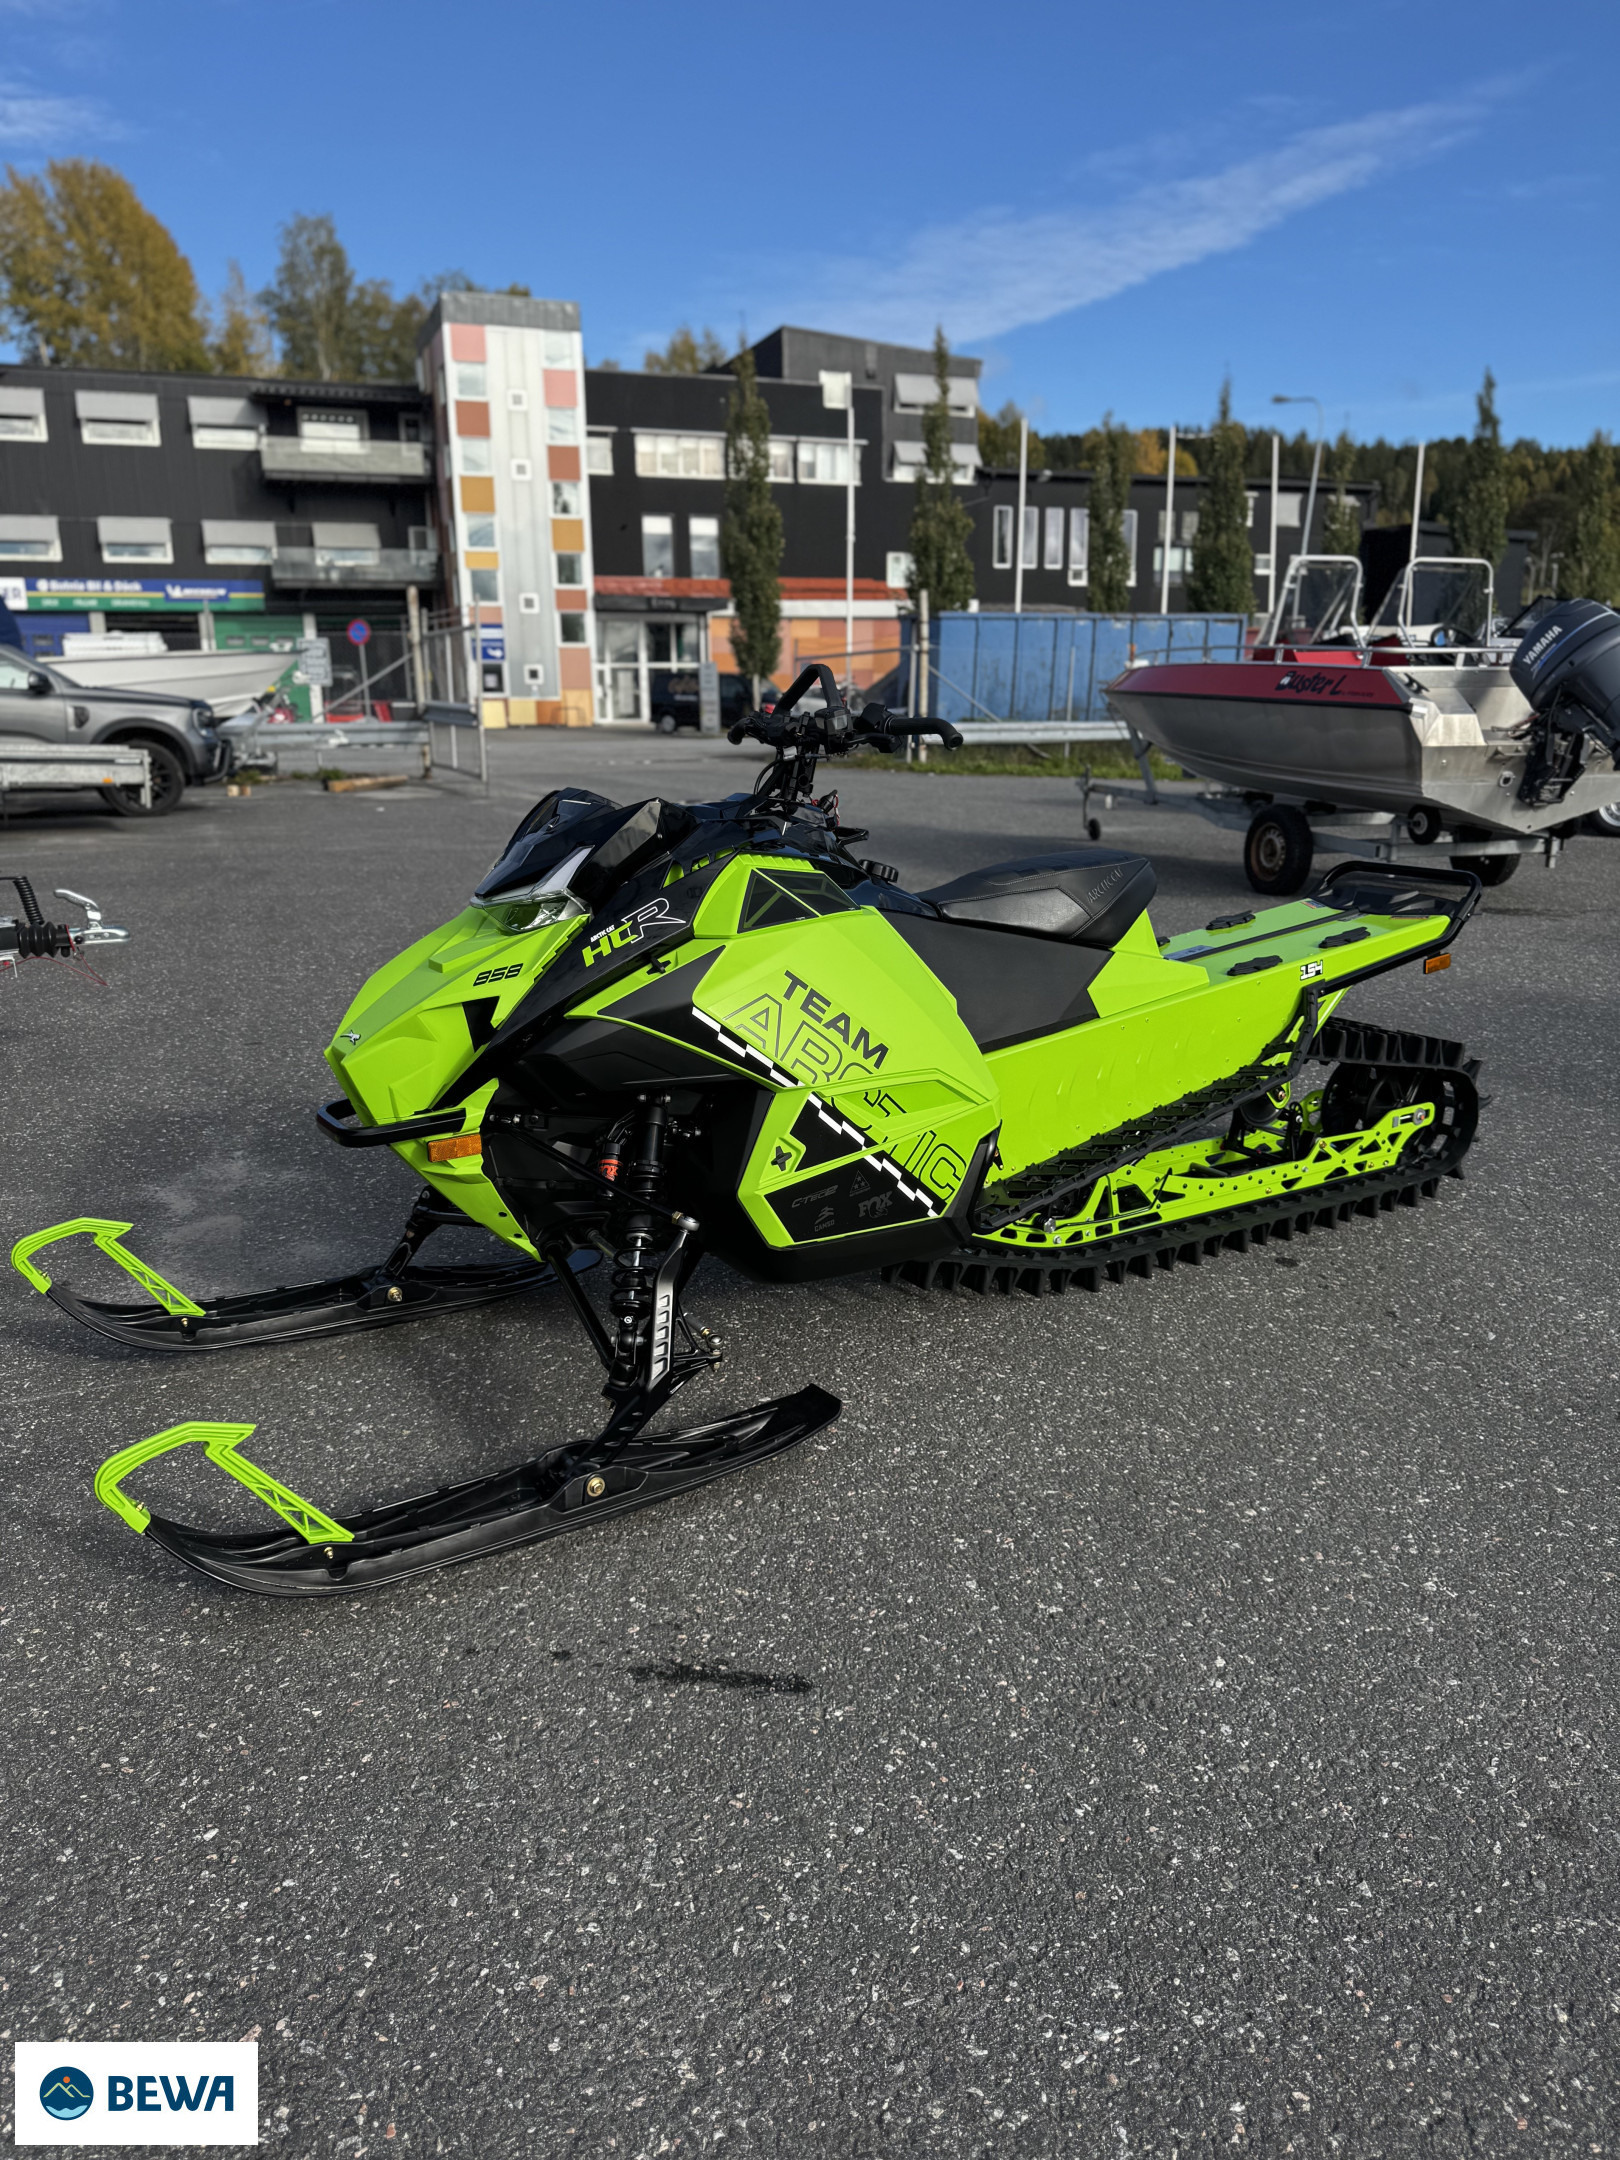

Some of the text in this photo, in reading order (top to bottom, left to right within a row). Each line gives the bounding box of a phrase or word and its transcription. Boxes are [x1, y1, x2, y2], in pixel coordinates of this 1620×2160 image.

[1522, 625, 1563, 665] YAMAHA
[1275, 670, 1347, 695] Buster L
[582, 897, 686, 967] HCR
[590, 924, 615, 943] ARCTIC CAT
[473, 963, 523, 987] 858
[1300, 960, 1323, 981] 154
[783, 970, 890, 1070] TEAM
[858, 1191, 893, 1219] FOX
[814, 1220, 835, 1232] CAMSO
